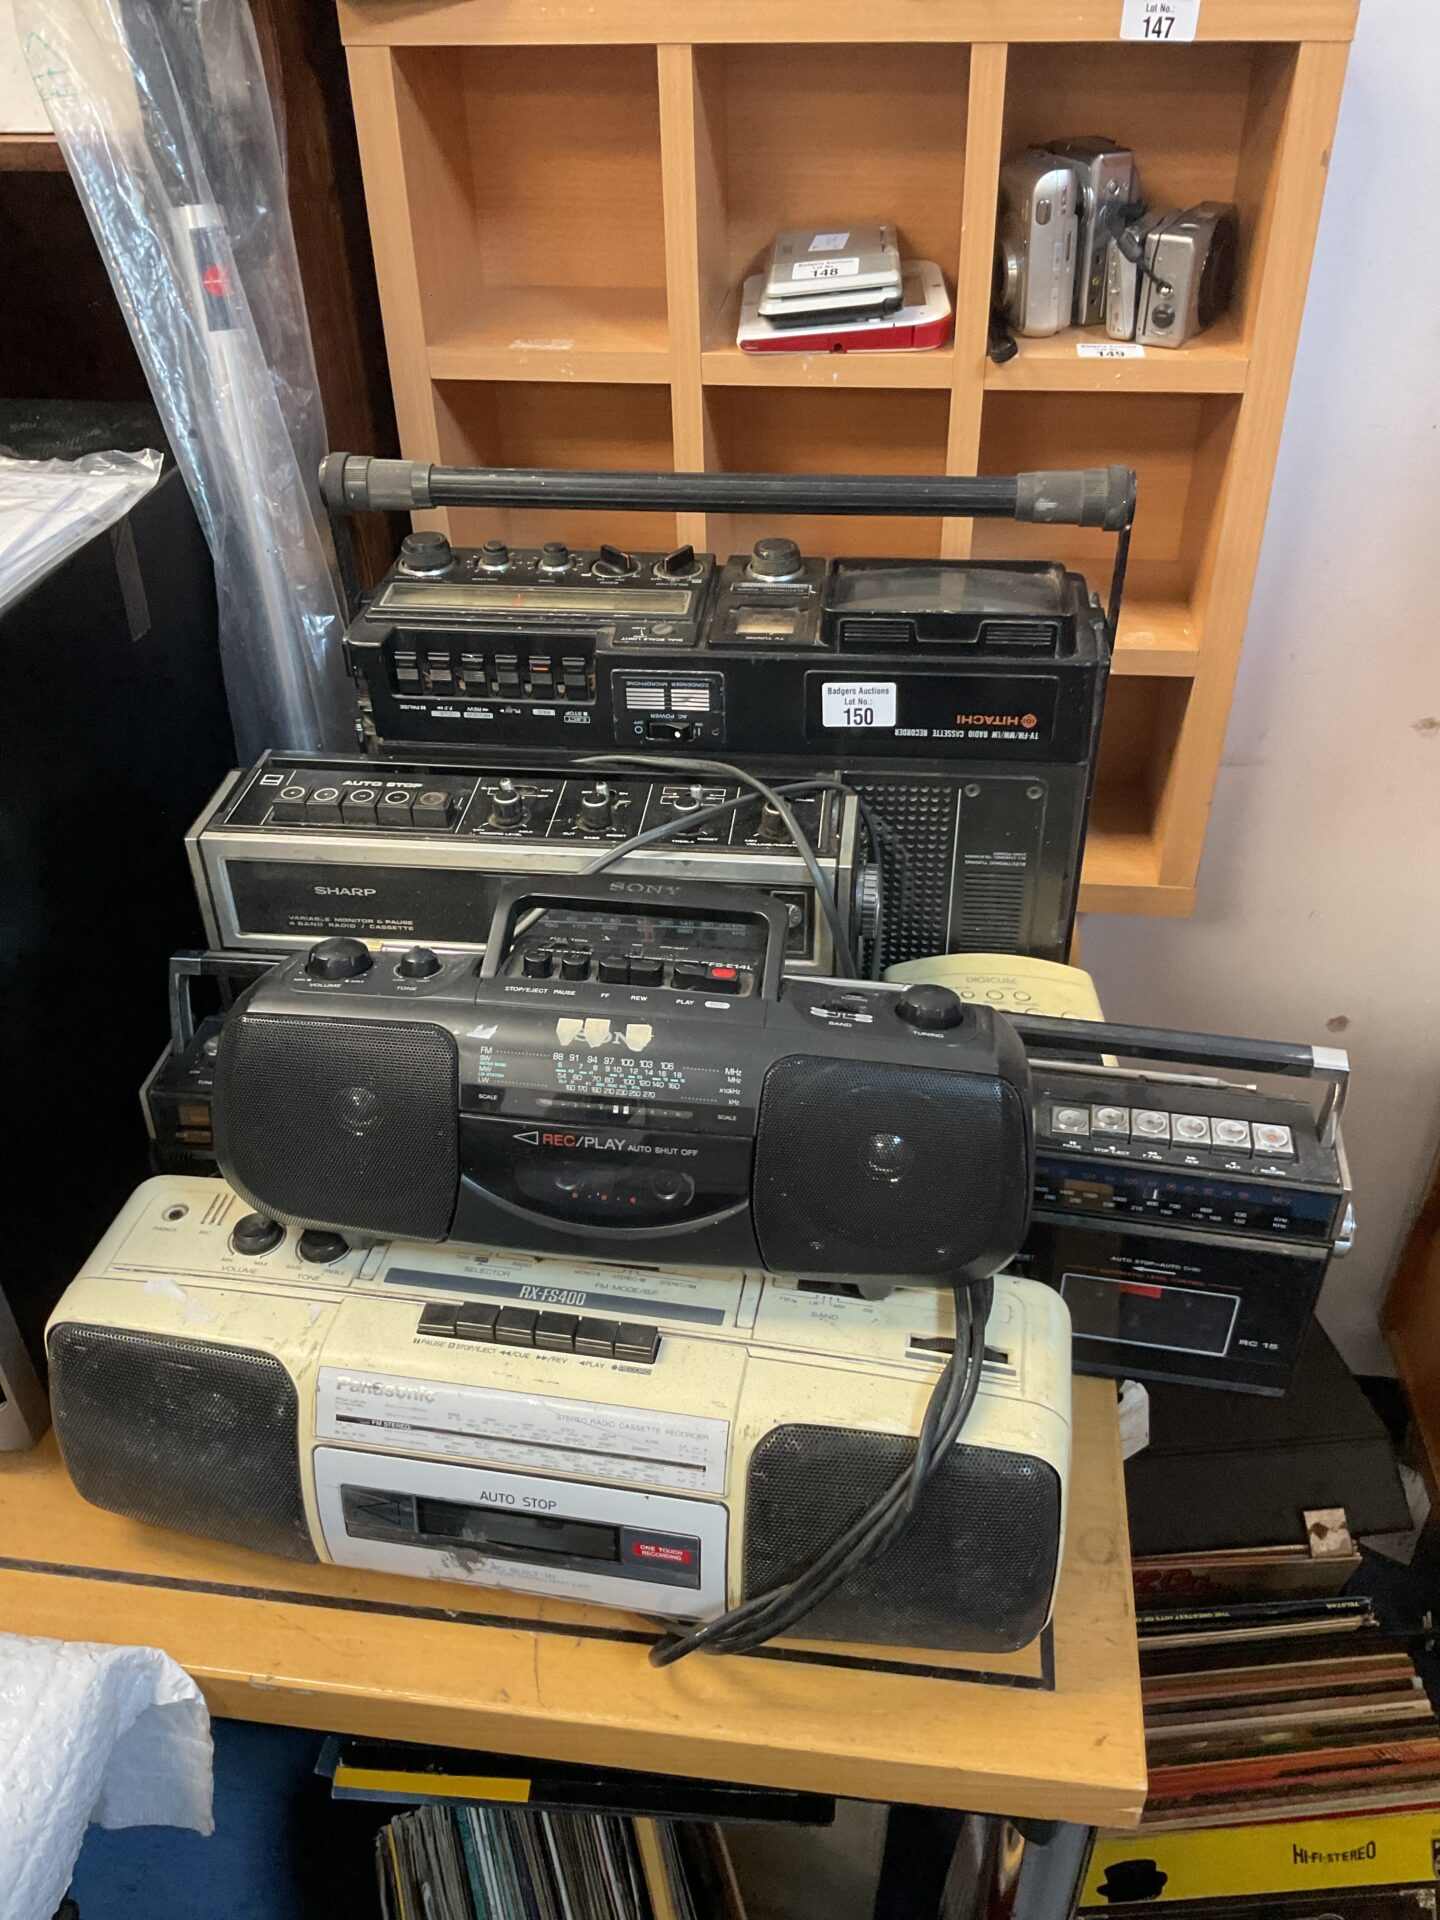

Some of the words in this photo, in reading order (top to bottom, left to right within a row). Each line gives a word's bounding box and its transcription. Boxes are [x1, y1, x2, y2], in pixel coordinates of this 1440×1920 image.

[1145, 3, 1158, 13] Lot
[1143, 16, 1176, 39] 147
[812, 268, 838, 278] 148
[827, 687, 857, 697] Badgers
[858, 687, 890, 695] Auctions
[844, 698, 855, 706] Lot
[843, 707, 874, 725] 150
[956, 714, 1020, 726] HITACHI
[894, 727, 928, 737] RECORDER
[932, 728, 965, 738] CASSETTE
[967, 729, 989, 738] RADIO
[991, 730, 1039, 740] TV-FM/MW/LW
[386, 781, 423, 789] STOP
[313, 886, 377, 897] SHARP
[609, 881, 683, 895] SONY
[288, 915, 331, 923] VARIABLE
[965, 976, 1018, 985] DIGICUBE
[505, 986, 549, 994] STOP/EJECT
[912, 1030, 945, 1039] TUNING
[480, 1046, 493, 1055] FM
[552, 1052, 564, 1061] 88
[569, 1054, 579, 1062] 91
[586, 1055, 598, 1064] 94
[603, 1057, 615, 1065] 97
[620, 1059, 635, 1067] 100
[639, 1060, 653, 1068] 103
[660, 1062, 674, 1070] 106
[724, 1068, 742, 1077] MHz
[572, 1073, 583, 1081] 60
[638, 1079, 651, 1087] 120
[668, 1082, 681, 1090] 160
[727, 1076, 742, 1084] MHz
[478, 1093, 498, 1101] SCALE
[643, 1091, 656, 1099] 270
[728, 1098, 740, 1106] kHz
[717, 1114, 737, 1122] SCALE
[542, 1132, 626, 1151] REC/PLAY
[628, 1144, 652, 1153] AUTO
[655, 1146, 679, 1155] SHUT
[680, 1148, 699, 1157] OFF
[1111, 1255, 1132, 1264] AUTO
[221, 1265, 259, 1275] VOLUME
[464, 1266, 512, 1278] SELECTOR
[296, 1273, 322, 1282] TONE
[519, 1284, 587, 1306] RX-FS400
[811, 1311, 839, 1321] BAND
[421, 1339, 444, 1348] PAUSE
[1238, 1338, 1258, 1348] RC
[1262, 1341, 1280, 1350] 15
[455, 1343, 497, 1355] STOP/EJECT
[584, 1360, 606, 1369] PLAY
[336, 1377, 436, 1404] Panasonic
[371, 1419, 383, 1427] FM
[383, 1421, 411, 1431] STEREO
[557, 1414, 588, 1425] STEREO
[590, 1417, 616, 1428] RADIO
[618, 1422, 662, 1434] CASSETTE
[665, 1429, 710, 1441] RECORDER
[480, 1490, 516, 1506] AUTO
[522, 1497, 558, 1511] STOP
[639, 1544, 656, 1552] ONE
[658, 1547, 684, 1556] TOUCH
[641, 1550, 683, 1561] RECORDING
[1155, 1614, 1173, 1622] HITS
[1175, 1612, 1213, 1620] GREATEST
[1214, 1611, 1231, 1619] THE
